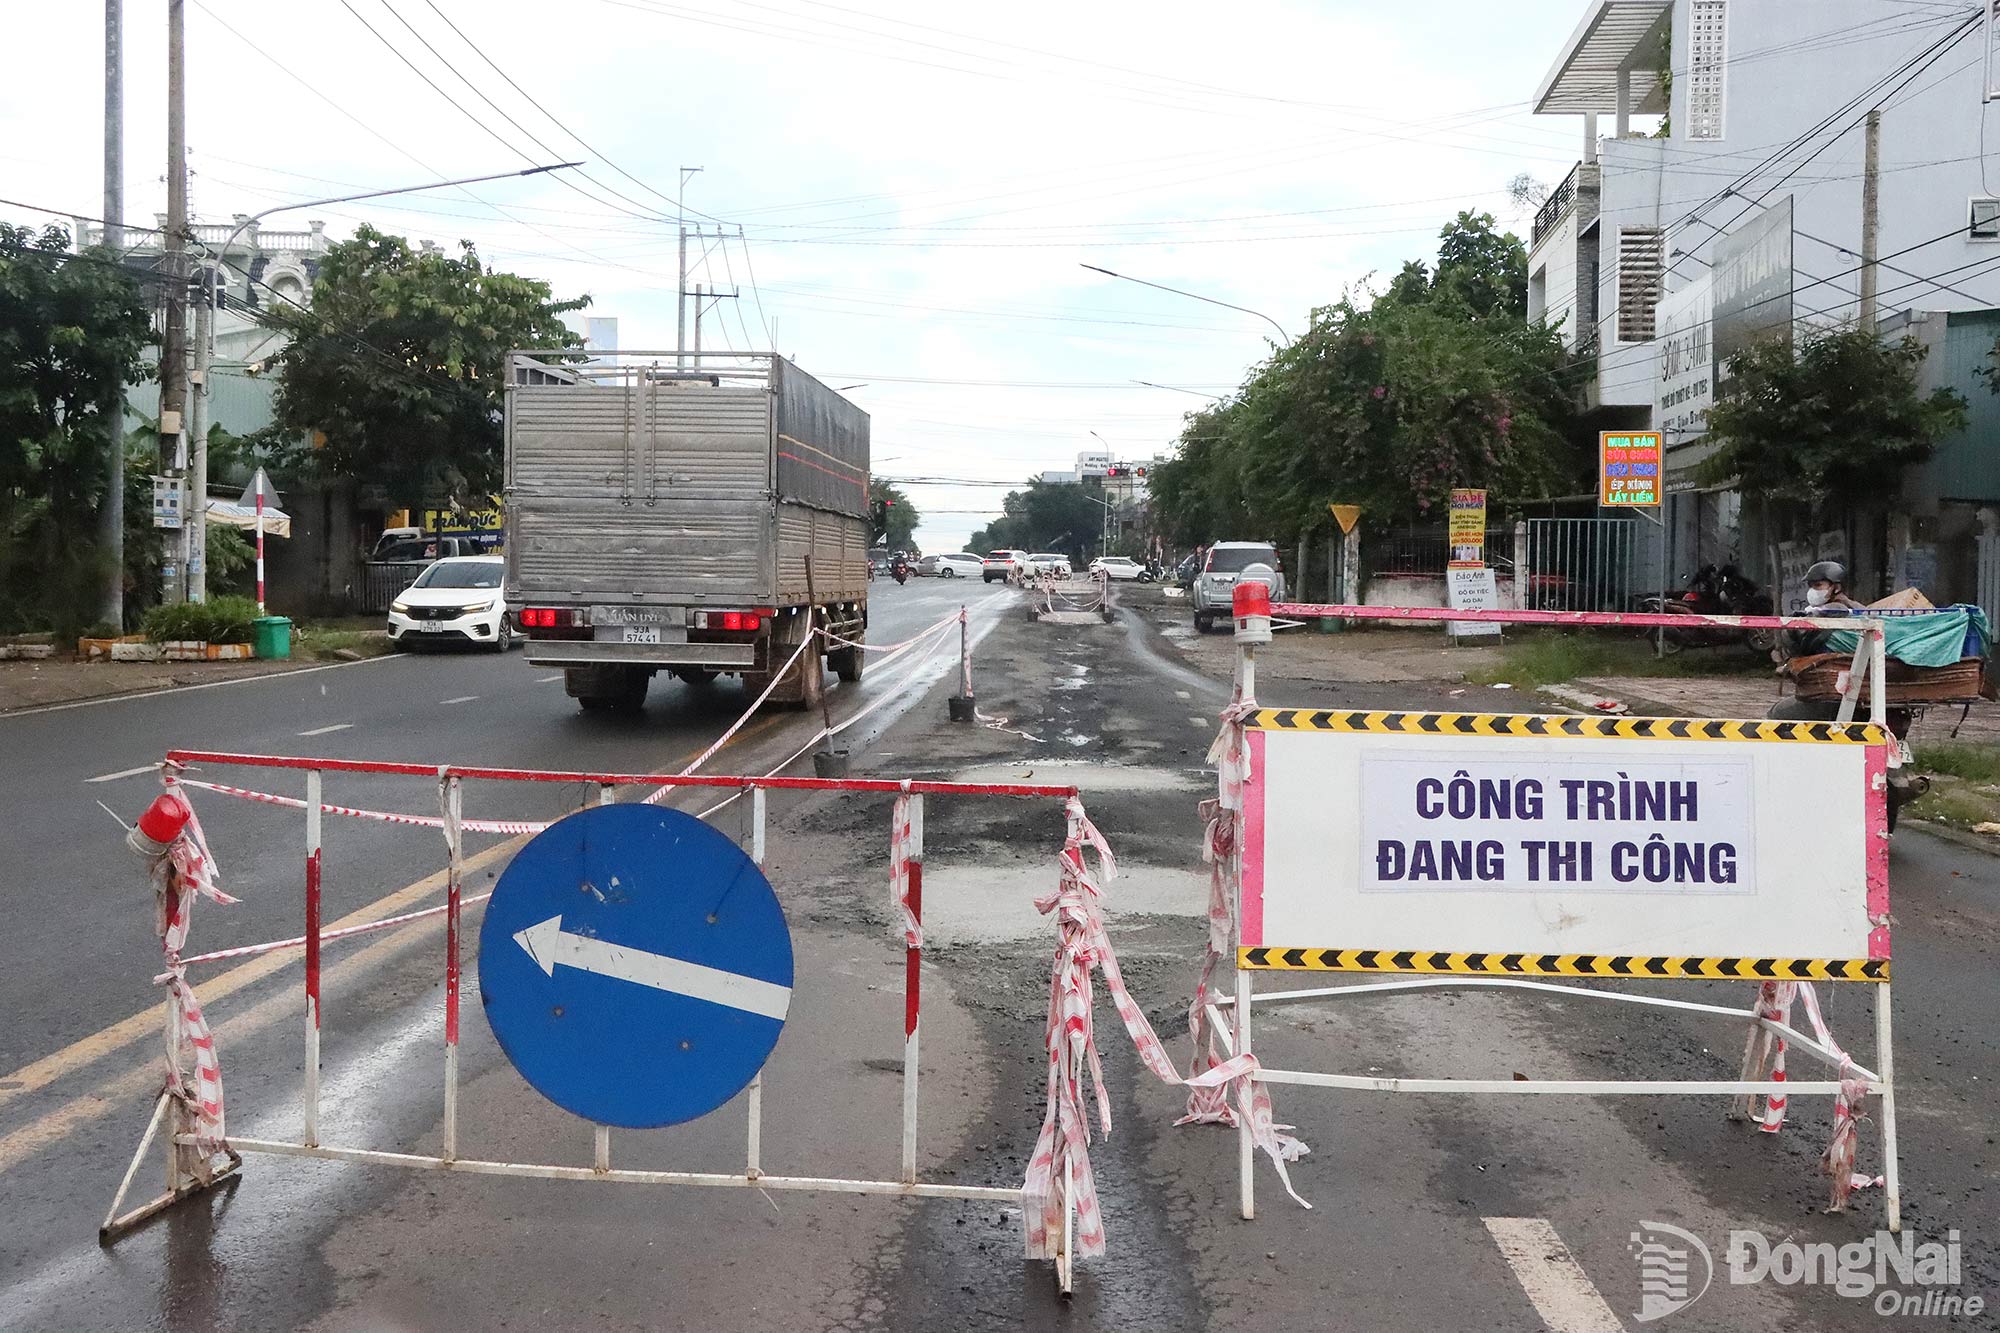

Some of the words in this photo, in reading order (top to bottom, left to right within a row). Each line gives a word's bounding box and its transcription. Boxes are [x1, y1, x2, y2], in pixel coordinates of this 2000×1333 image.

[1607, 437, 1631, 447] MUA
[1633, 435, 1656, 447] BÁN
[1606, 448, 1628, 460] SỬA
[1629, 448, 1658, 460] CHỮA
[1611, 478, 1625, 490] ÉP
[1627, 478, 1653, 490] KÍNH
[1608, 489, 1628, 503] LẤY
[633, 625, 650, 634] 93A
[1416, 770, 1543, 820] CÔNG
[1560, 772, 1698, 822] TRÌNH
[1376, 840, 1505, 881] ĐANG
[1521, 840, 1592, 881] THI
[1610, 833, 1737, 884] CÔNG
